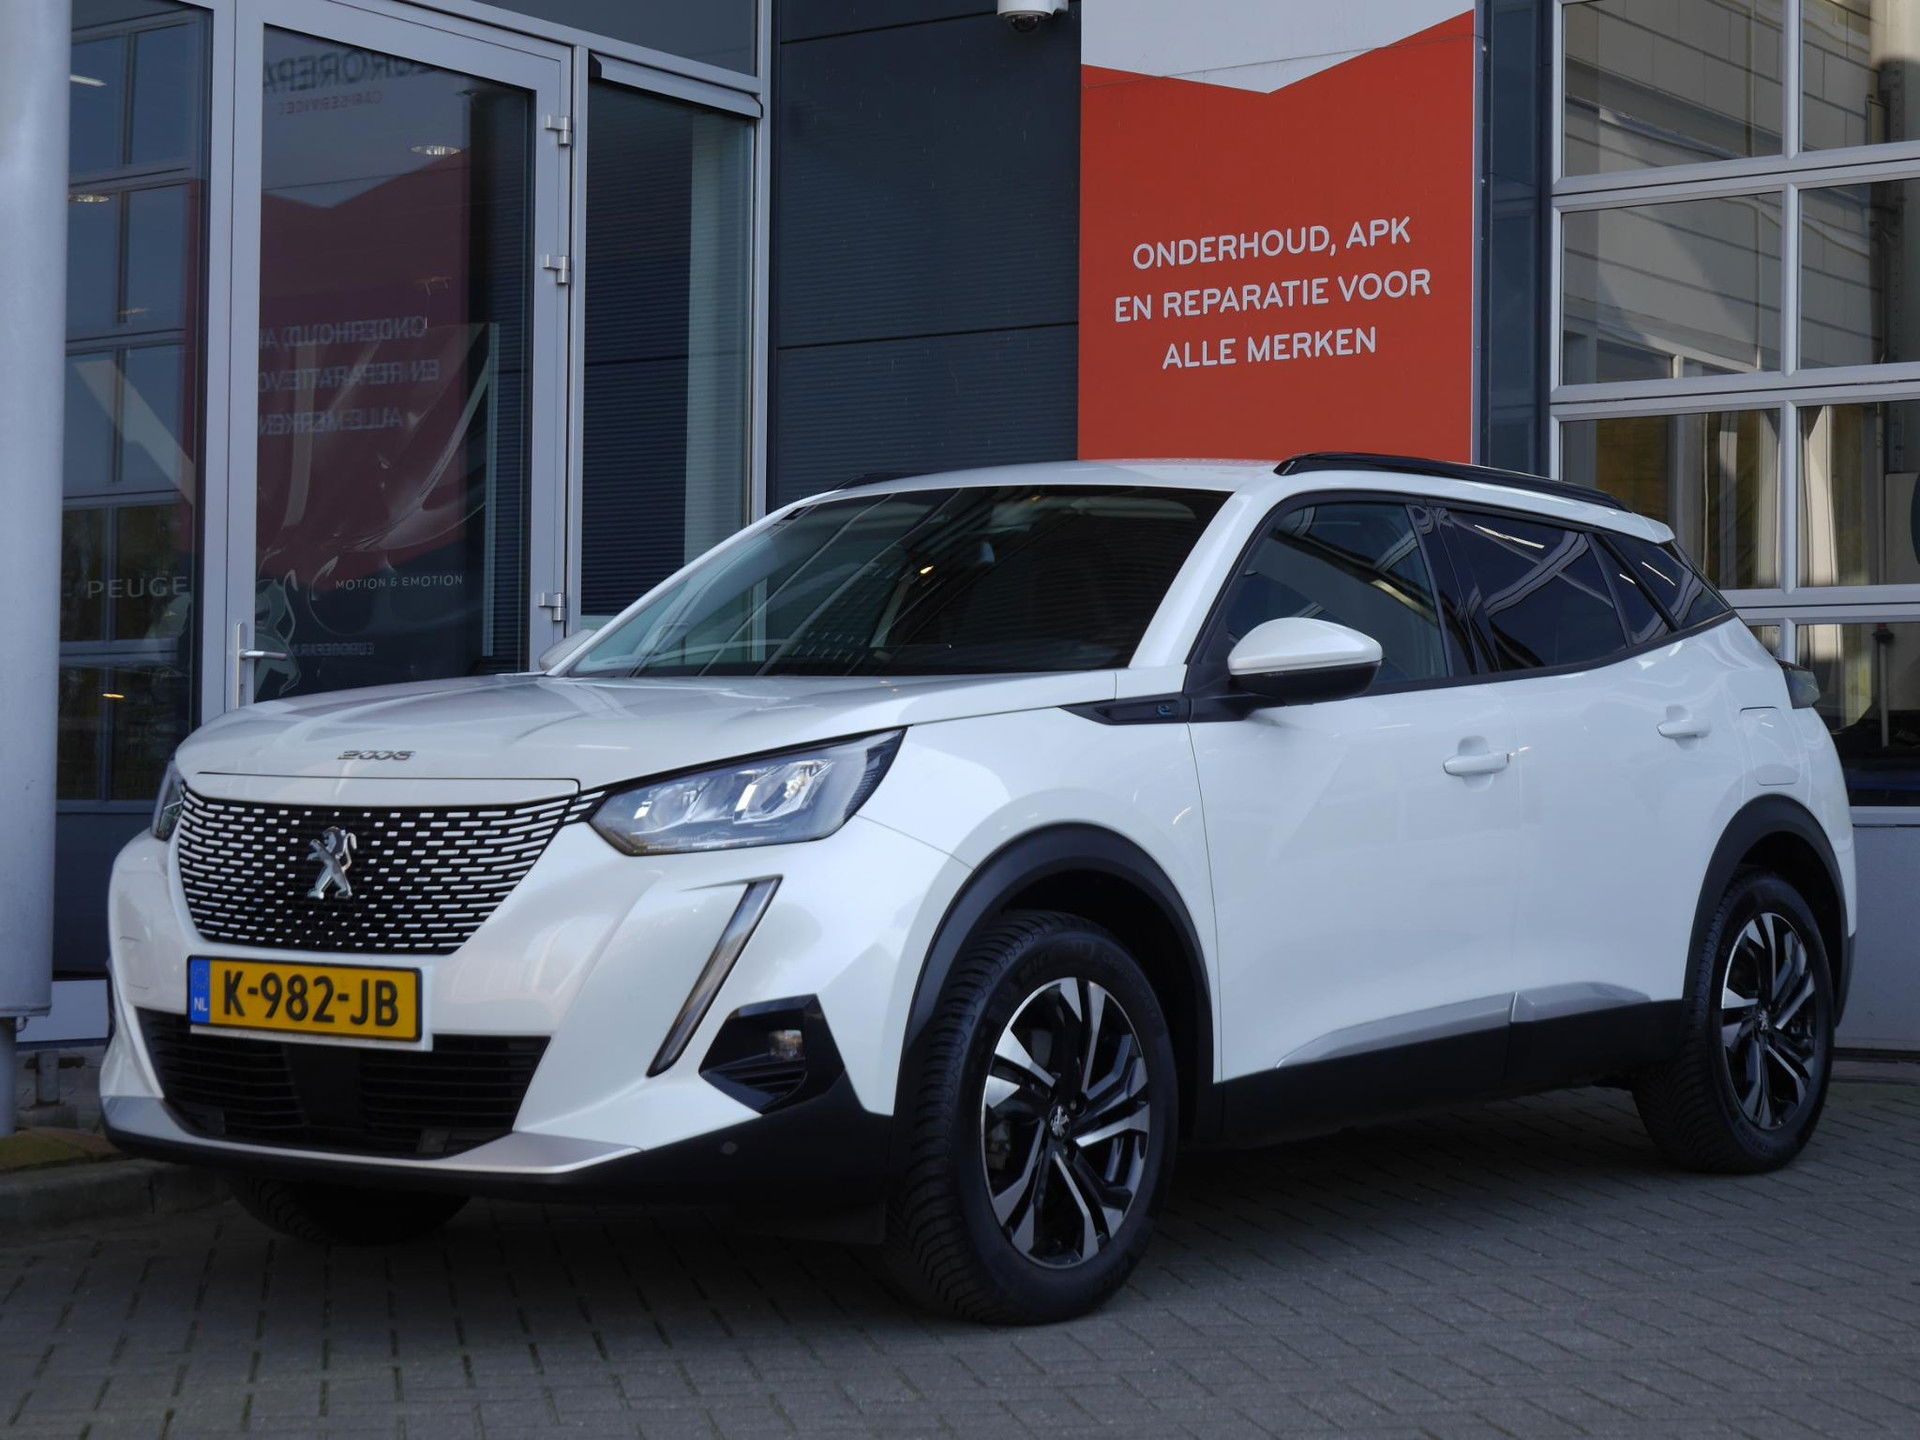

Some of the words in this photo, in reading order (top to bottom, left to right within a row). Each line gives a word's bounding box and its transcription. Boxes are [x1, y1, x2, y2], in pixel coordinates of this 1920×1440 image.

[1133, 226, 1337, 270] ONDERHOUD,
[1345, 217, 1411, 249] APK
[1115, 294, 1152, 323] EN
[1163, 277, 1329, 318] REPARATIE
[1337, 269, 1431, 302] VOOR
[1162, 338, 1237, 370] ALLE
[1247, 327, 1376, 362] MERKEN
[335, 577, 386, 591] MOTION
[401, 574, 464, 588] EMOTION
[193, 997, 209, 1012] NL
[224, 970, 399, 1027] K-982-JB
